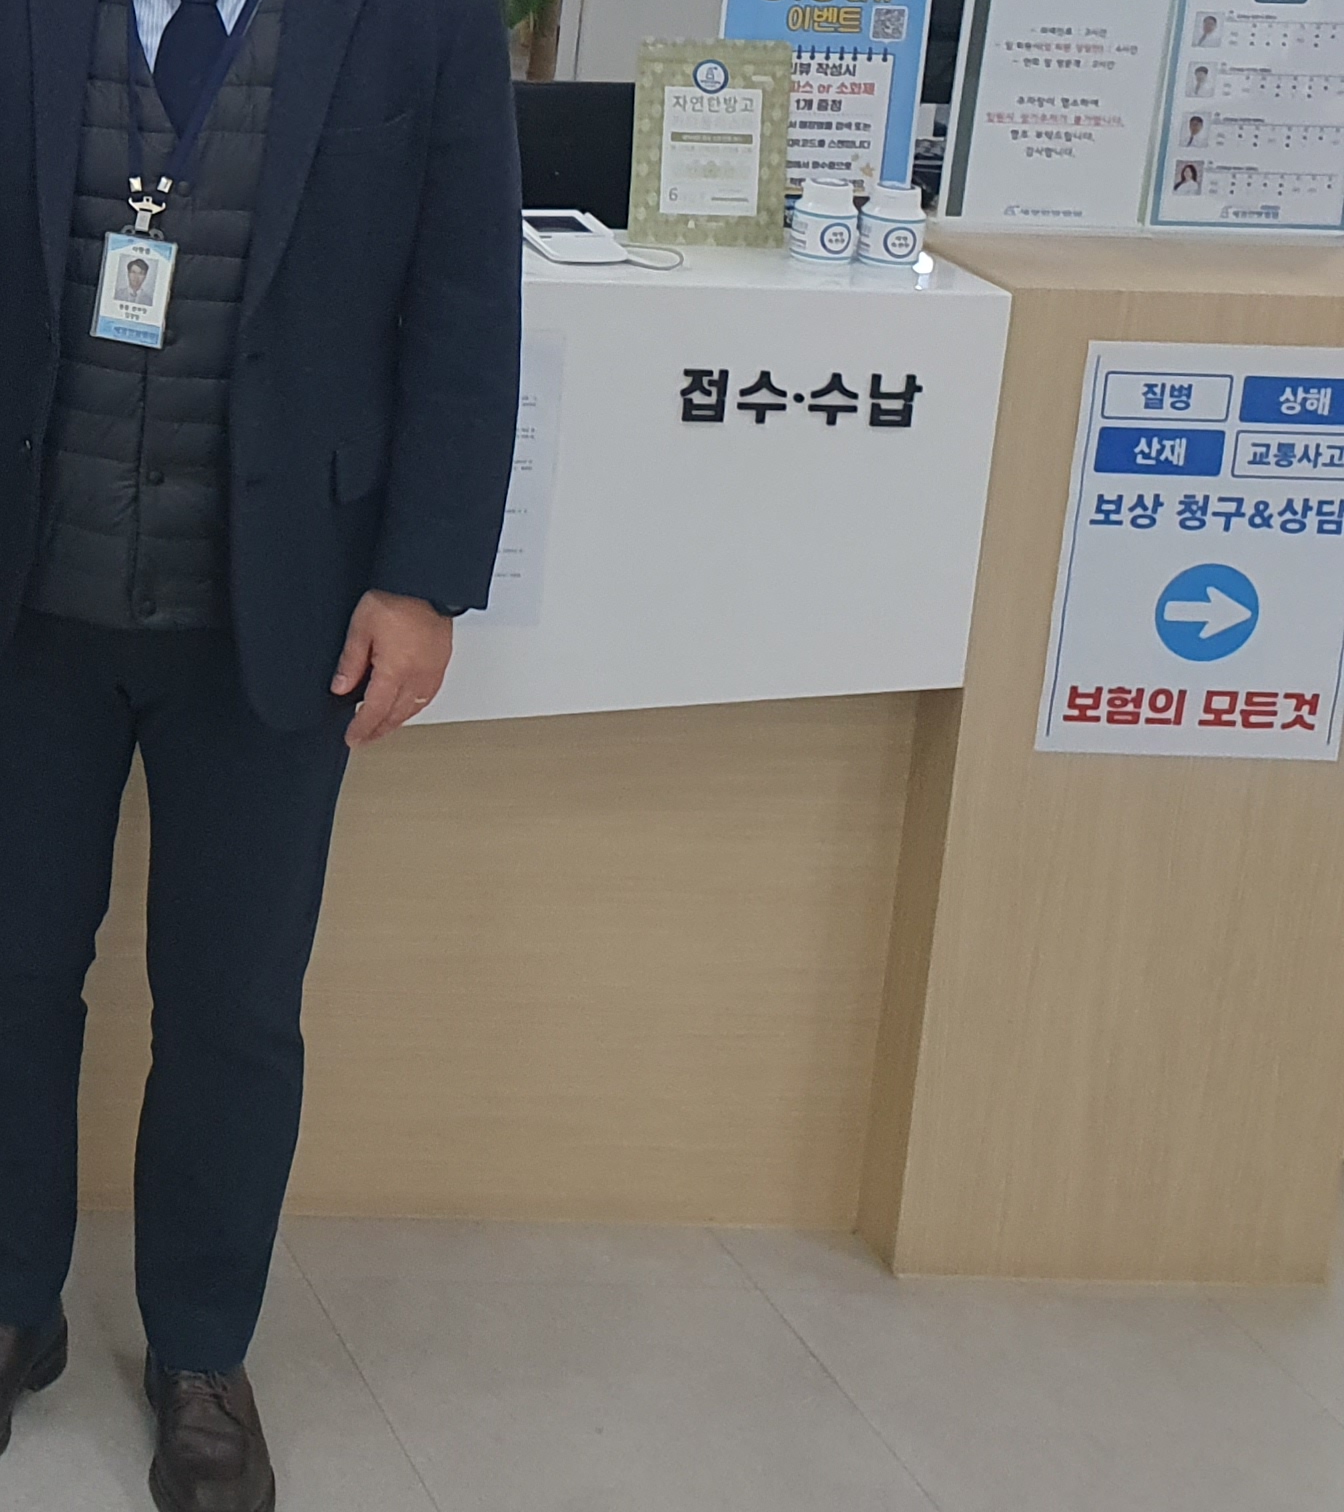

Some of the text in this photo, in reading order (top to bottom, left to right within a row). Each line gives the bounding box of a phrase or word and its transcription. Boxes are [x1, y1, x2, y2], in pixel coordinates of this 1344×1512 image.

[787, 6, 863, 33] 이벤트
[679, 368, 923, 427] 접수·수납
[1141, 382, 1193, 411] 질병
[1279, 386, 1332, 416] 상해
[1133, 437, 1187, 467] 산재
[1247, 441, 1344, 469] 교통사고
[1089, 493, 1164, 529] 보상
[1062, 684, 1320, 731] 보험의 모든것
